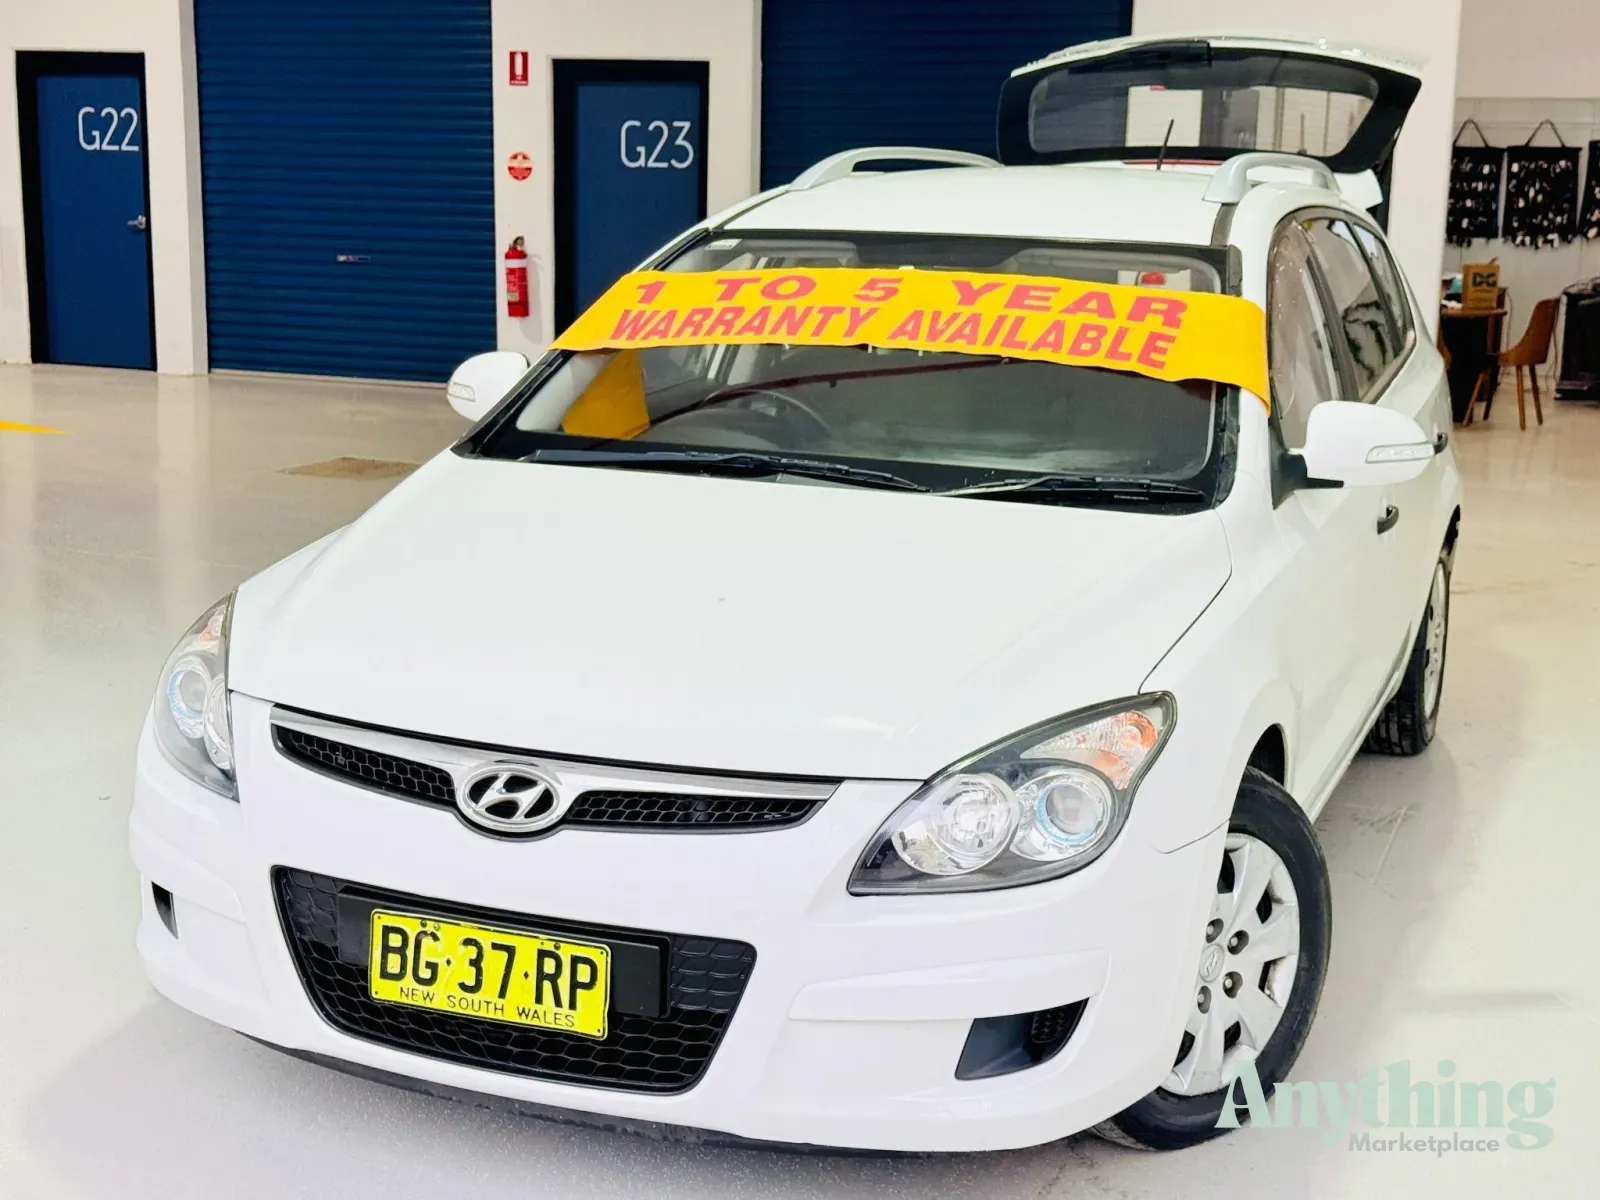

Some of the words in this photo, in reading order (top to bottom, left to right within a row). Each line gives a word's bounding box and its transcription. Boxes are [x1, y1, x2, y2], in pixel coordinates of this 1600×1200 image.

[78, 106, 140, 151] G22
[620, 120, 694, 169] G23
[636, 280, 668, 304] 1
[715, 275, 817, 302] TO
[854, 278, 904, 302] 5
[951, 279, 1189, 329] YEAR
[609, 305, 879, 341] WARRANTY
[887, 309, 1177, 369] AVAILABLE
[399, 986, 435, 1002] NEW
[447, 995, 505, 1014] SOUTH
[517, 1005, 575, 1027] WALES
